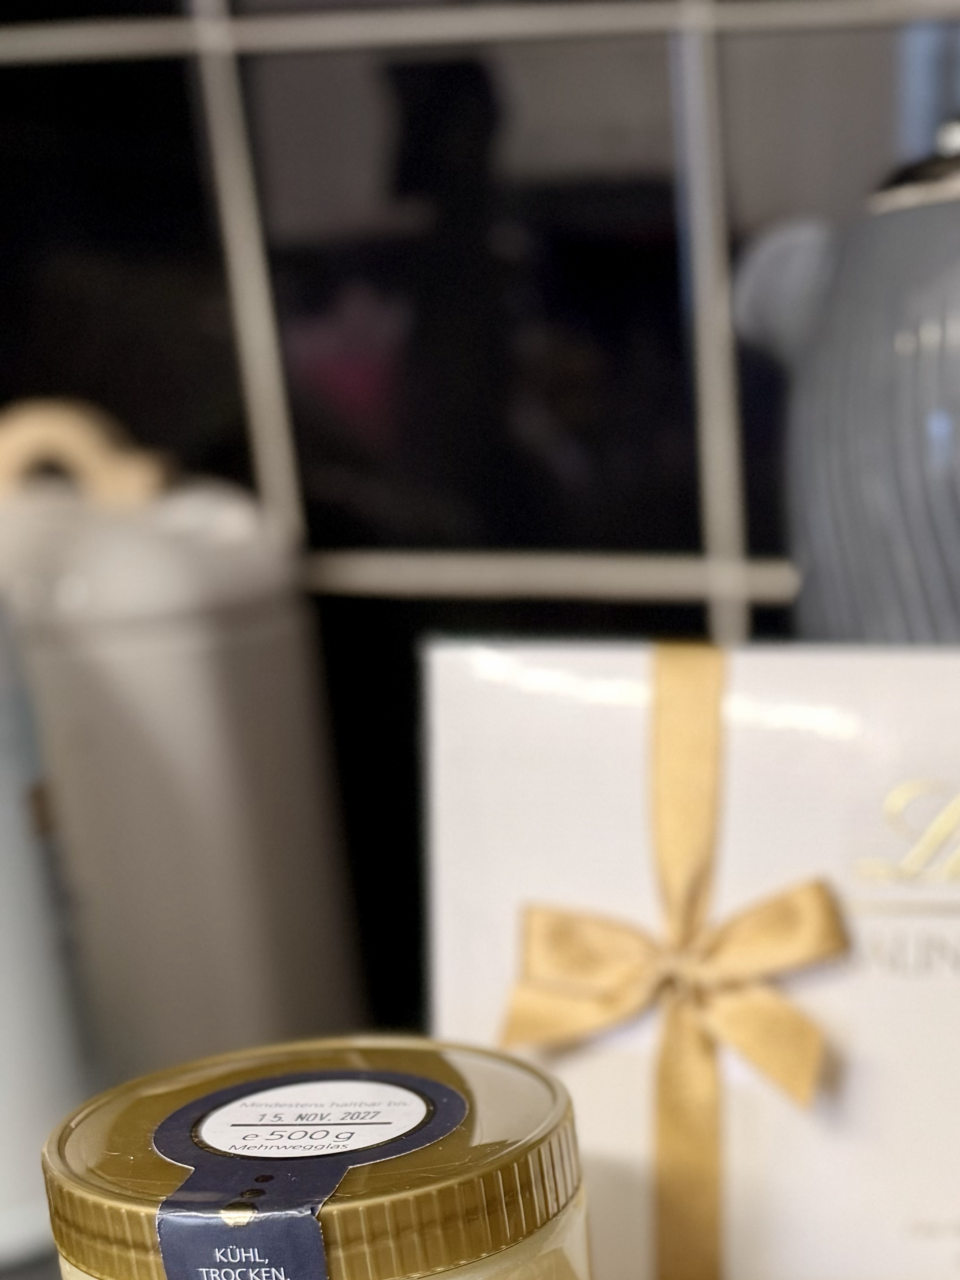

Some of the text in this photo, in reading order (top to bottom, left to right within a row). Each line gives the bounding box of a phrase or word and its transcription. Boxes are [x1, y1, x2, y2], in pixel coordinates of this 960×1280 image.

[240, 1100, 325, 1109] Mindestens
[330, 1100, 382, 1109] haltbar
[294, 1112, 332, 1122] NOV.
[340, 1110, 382, 1121] 2027
[228, 1143, 350, 1152] Mehrwegglas
[215, 1245, 270, 1265] KÜHL,
